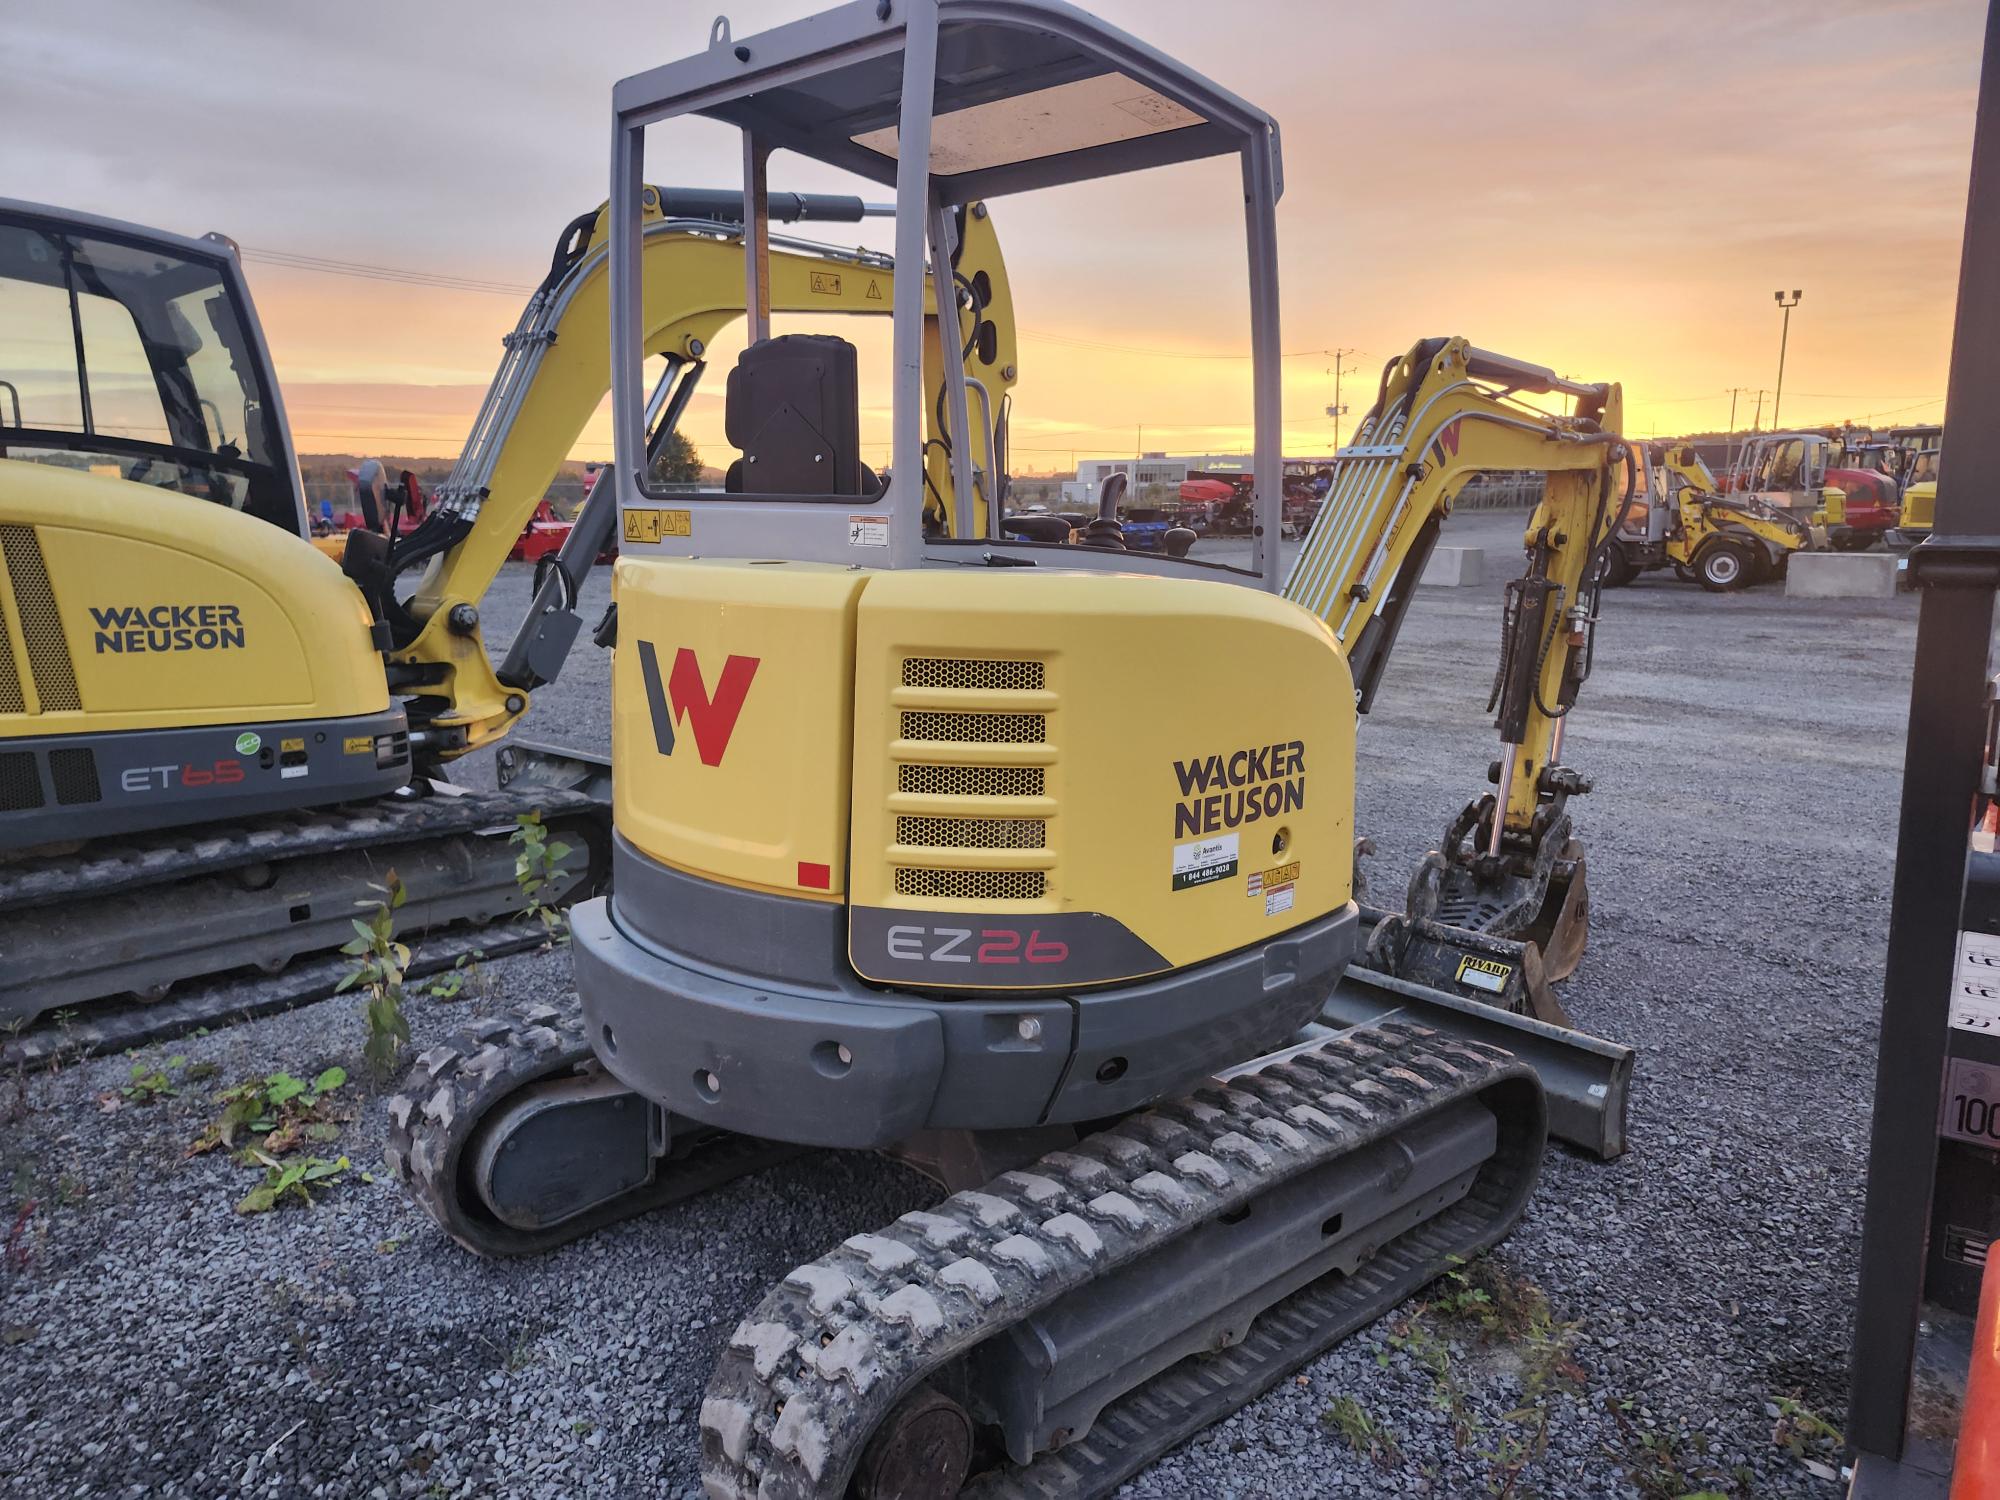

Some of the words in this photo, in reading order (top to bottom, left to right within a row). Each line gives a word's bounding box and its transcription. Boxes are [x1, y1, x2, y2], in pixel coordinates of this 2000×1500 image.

[88, 605, 243, 630] WACKER
[95, 628, 245, 654] NEUSON
[637, 640, 760, 767] W
[121, 760, 244, 792] ET65
[1173, 740, 1305, 797] WACKER
[1175, 777, 1304, 839] NEUSON
[1202, 843, 1222, 854] Avantis
[1188, 871, 1200, 881] 844
[888, 925, 1069, 963] EZ26
[1463, 956, 1510, 976] RIVARD
